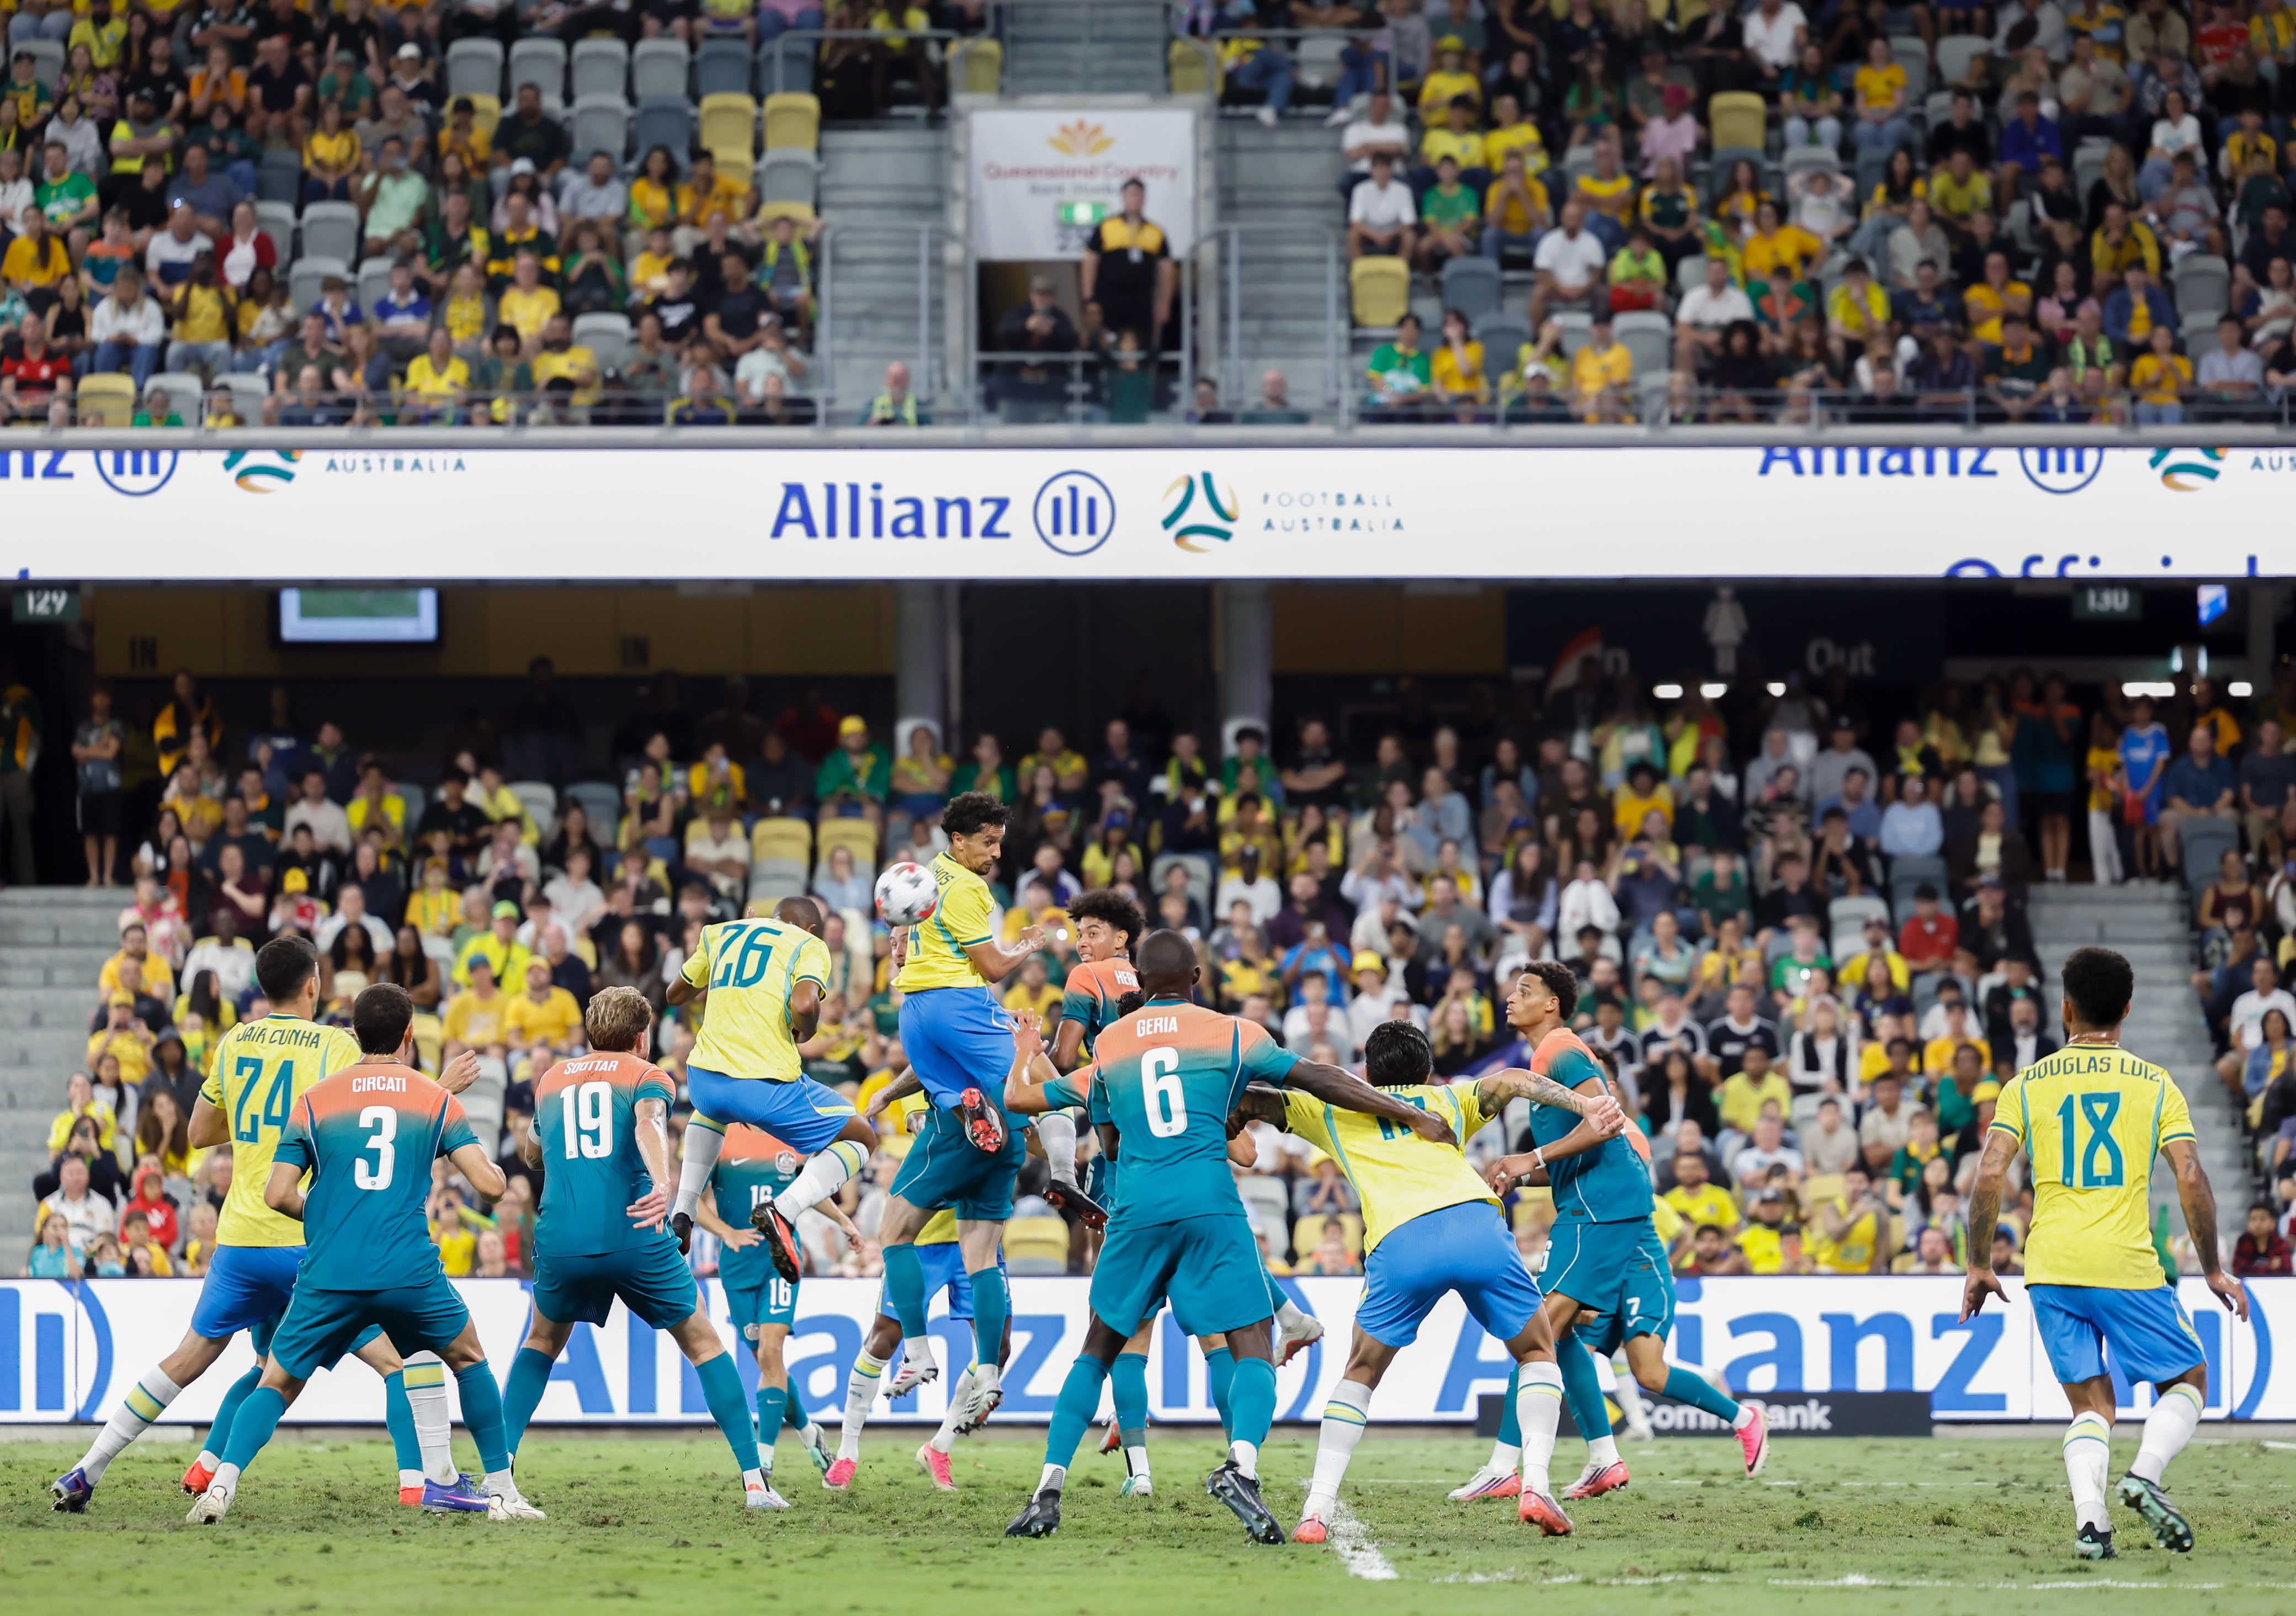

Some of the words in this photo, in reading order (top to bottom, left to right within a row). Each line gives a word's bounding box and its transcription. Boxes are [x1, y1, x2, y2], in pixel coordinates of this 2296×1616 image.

[326, 458, 467, 473] AUSTRALIA
[770, 482, 1012, 540] Allianz
[1262, 493, 1395, 508] FOOTBALL
[1263, 518, 1405, 533] AUSTRALIA
[26, 590, 68, 615] 129
[130, 634, 159, 671] IN
[1807, 637, 1875, 676] Out
[709, 924, 782, 990] 26
[236, 1025, 267, 1044] JAIR
[269, 1029, 321, 1049] CUNHA
[1136, 1017, 1178, 1038] GERIA
[564, 1060, 619, 1075] SOUTTAR
[2025, 1056, 2111, 1082] DOUGLAS
[2120, 1057, 2162, 1082] LUIZ
[352, 1075, 407, 1093] CIRCATI
[1140, 1046, 1188, 1138] 6
[235, 1056, 294, 1143] 24
[560, 1081, 614, 1160] 19
[355, 1105, 398, 1190] 3
[2056, 1091, 2124, 1188] 18
[750, 1184, 773, 1208] 16
[769, 1278, 792, 1307] 16
[1626, 1297, 1641, 1316] 7
[1639, 1398, 1833, 1431] Comank
